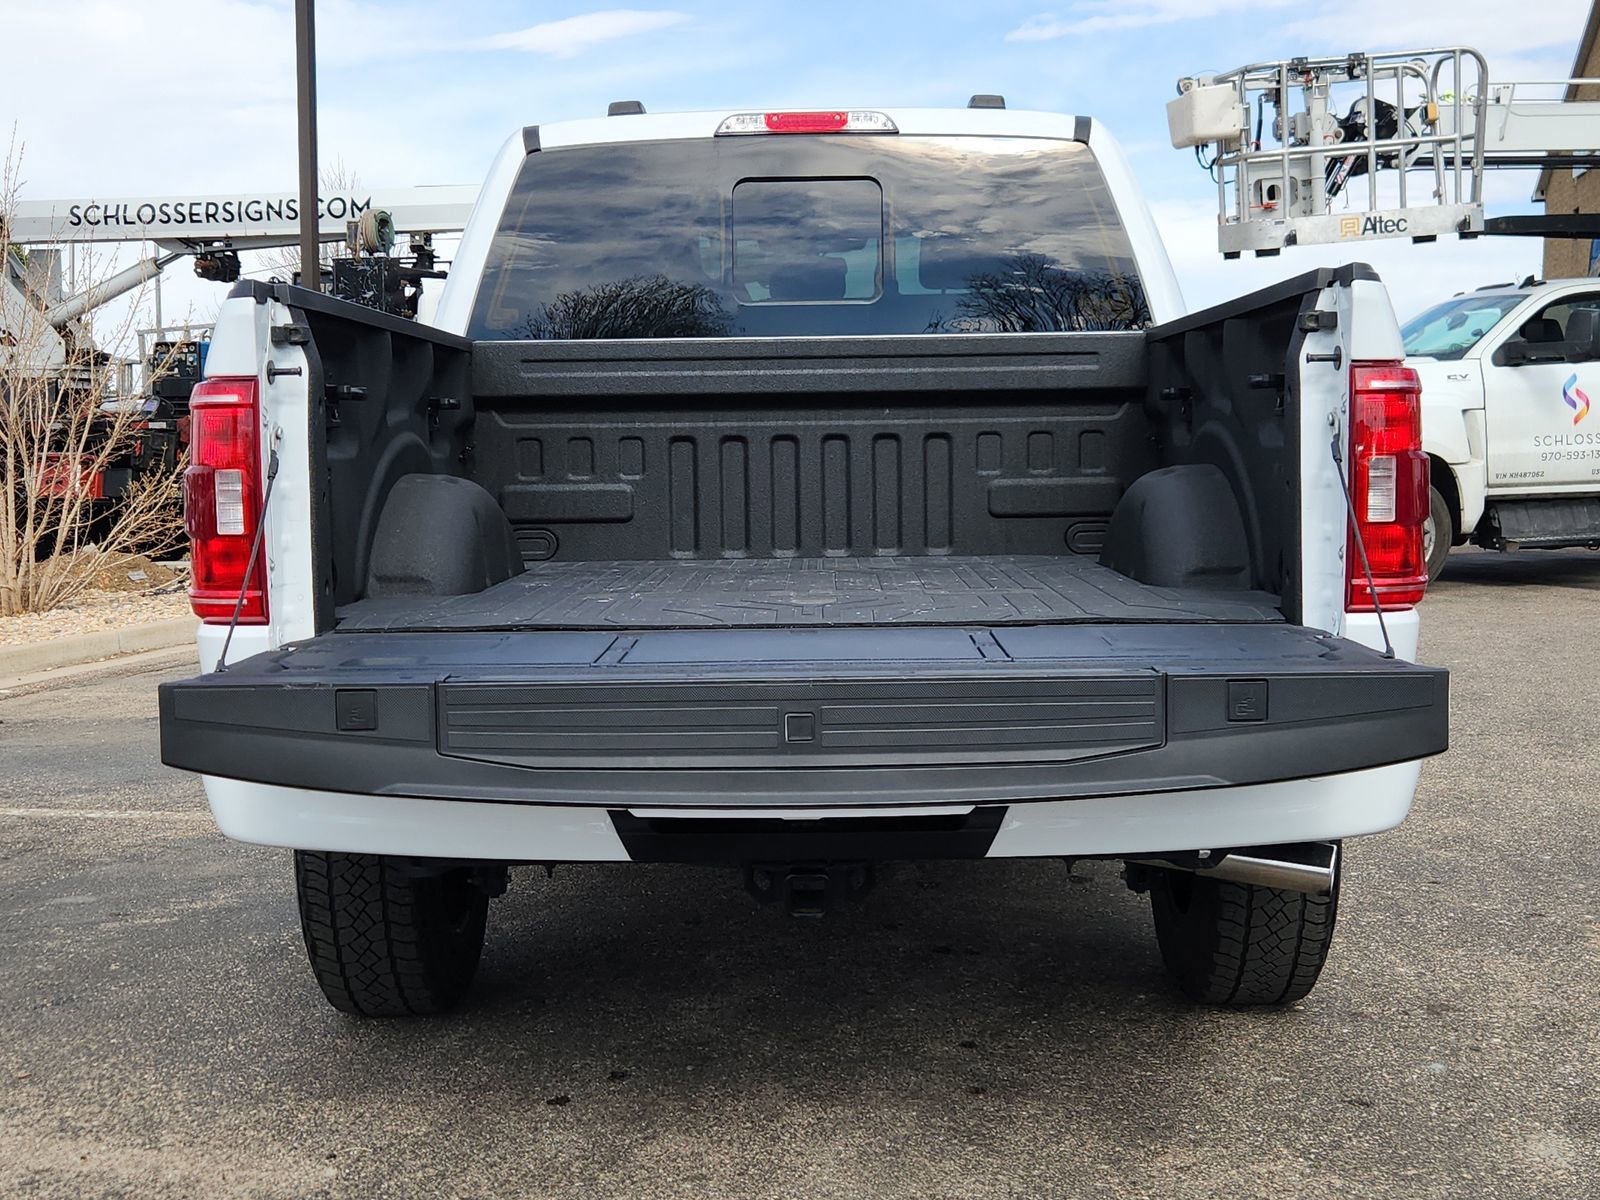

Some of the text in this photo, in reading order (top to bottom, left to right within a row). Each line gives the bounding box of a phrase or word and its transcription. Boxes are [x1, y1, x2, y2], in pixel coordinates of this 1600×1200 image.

[69, 196, 371, 226] SCHLOSSERSIGNSOM
[1361, 215, 1408, 236] Altec
[1534, 433, 1600, 447] SCHLOSS
[1541, 450, 1600, 461] 970-593-13
[1495, 472, 1508, 480] VIN
